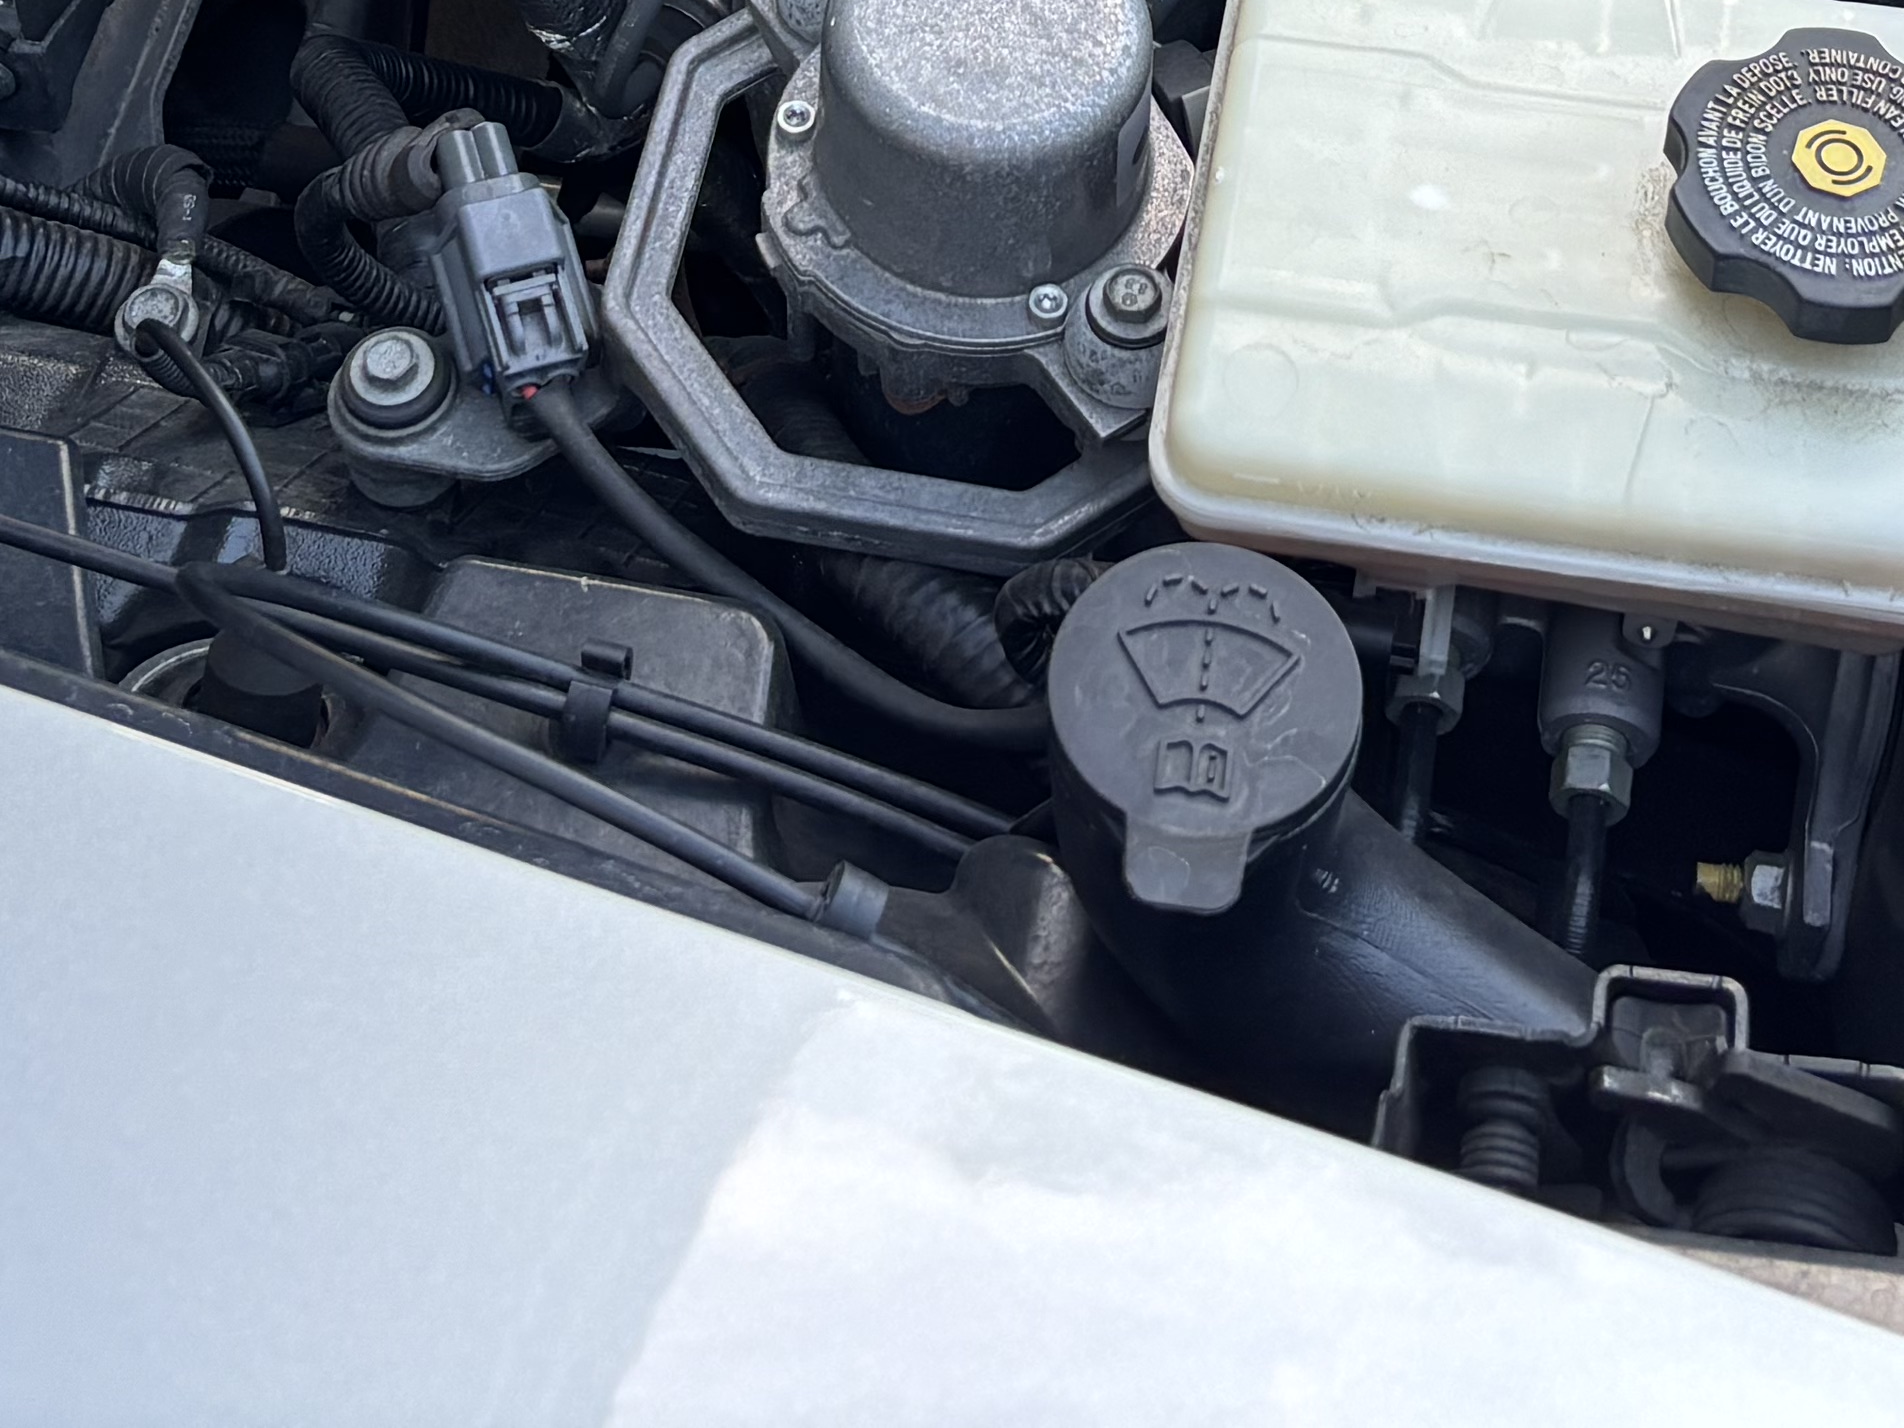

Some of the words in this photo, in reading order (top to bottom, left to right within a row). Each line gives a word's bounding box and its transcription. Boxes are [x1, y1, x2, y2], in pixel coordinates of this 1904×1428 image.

[1808, 65, 1849, 83] ONLY
[1851, 69, 1886, 93] USE
[1715, 83, 1743, 105] LA
[1815, 84, 1876, 109] FILLER
[1697, 101, 1728, 143] AVANT
[1726, 89, 1768, 129] FREIN
[1721, 128, 1744, 150] DE
[1746, 132, 1771, 179] BIDON
[1698, 148, 1740, 216] BOUCHON
[1721, 151, 1760, 206] LIQUIDE
[1758, 178, 1796, 213] D'UN
[1729, 211, 1756, 235] LE
[1750, 202, 1778, 227] DU
[1793, 206, 1900, 234] PROVENANT
[1773, 218, 1813, 247] QUE
[1751, 227, 1837, 276] NETTOYER
[1584, 657, 1633, 691] 25
